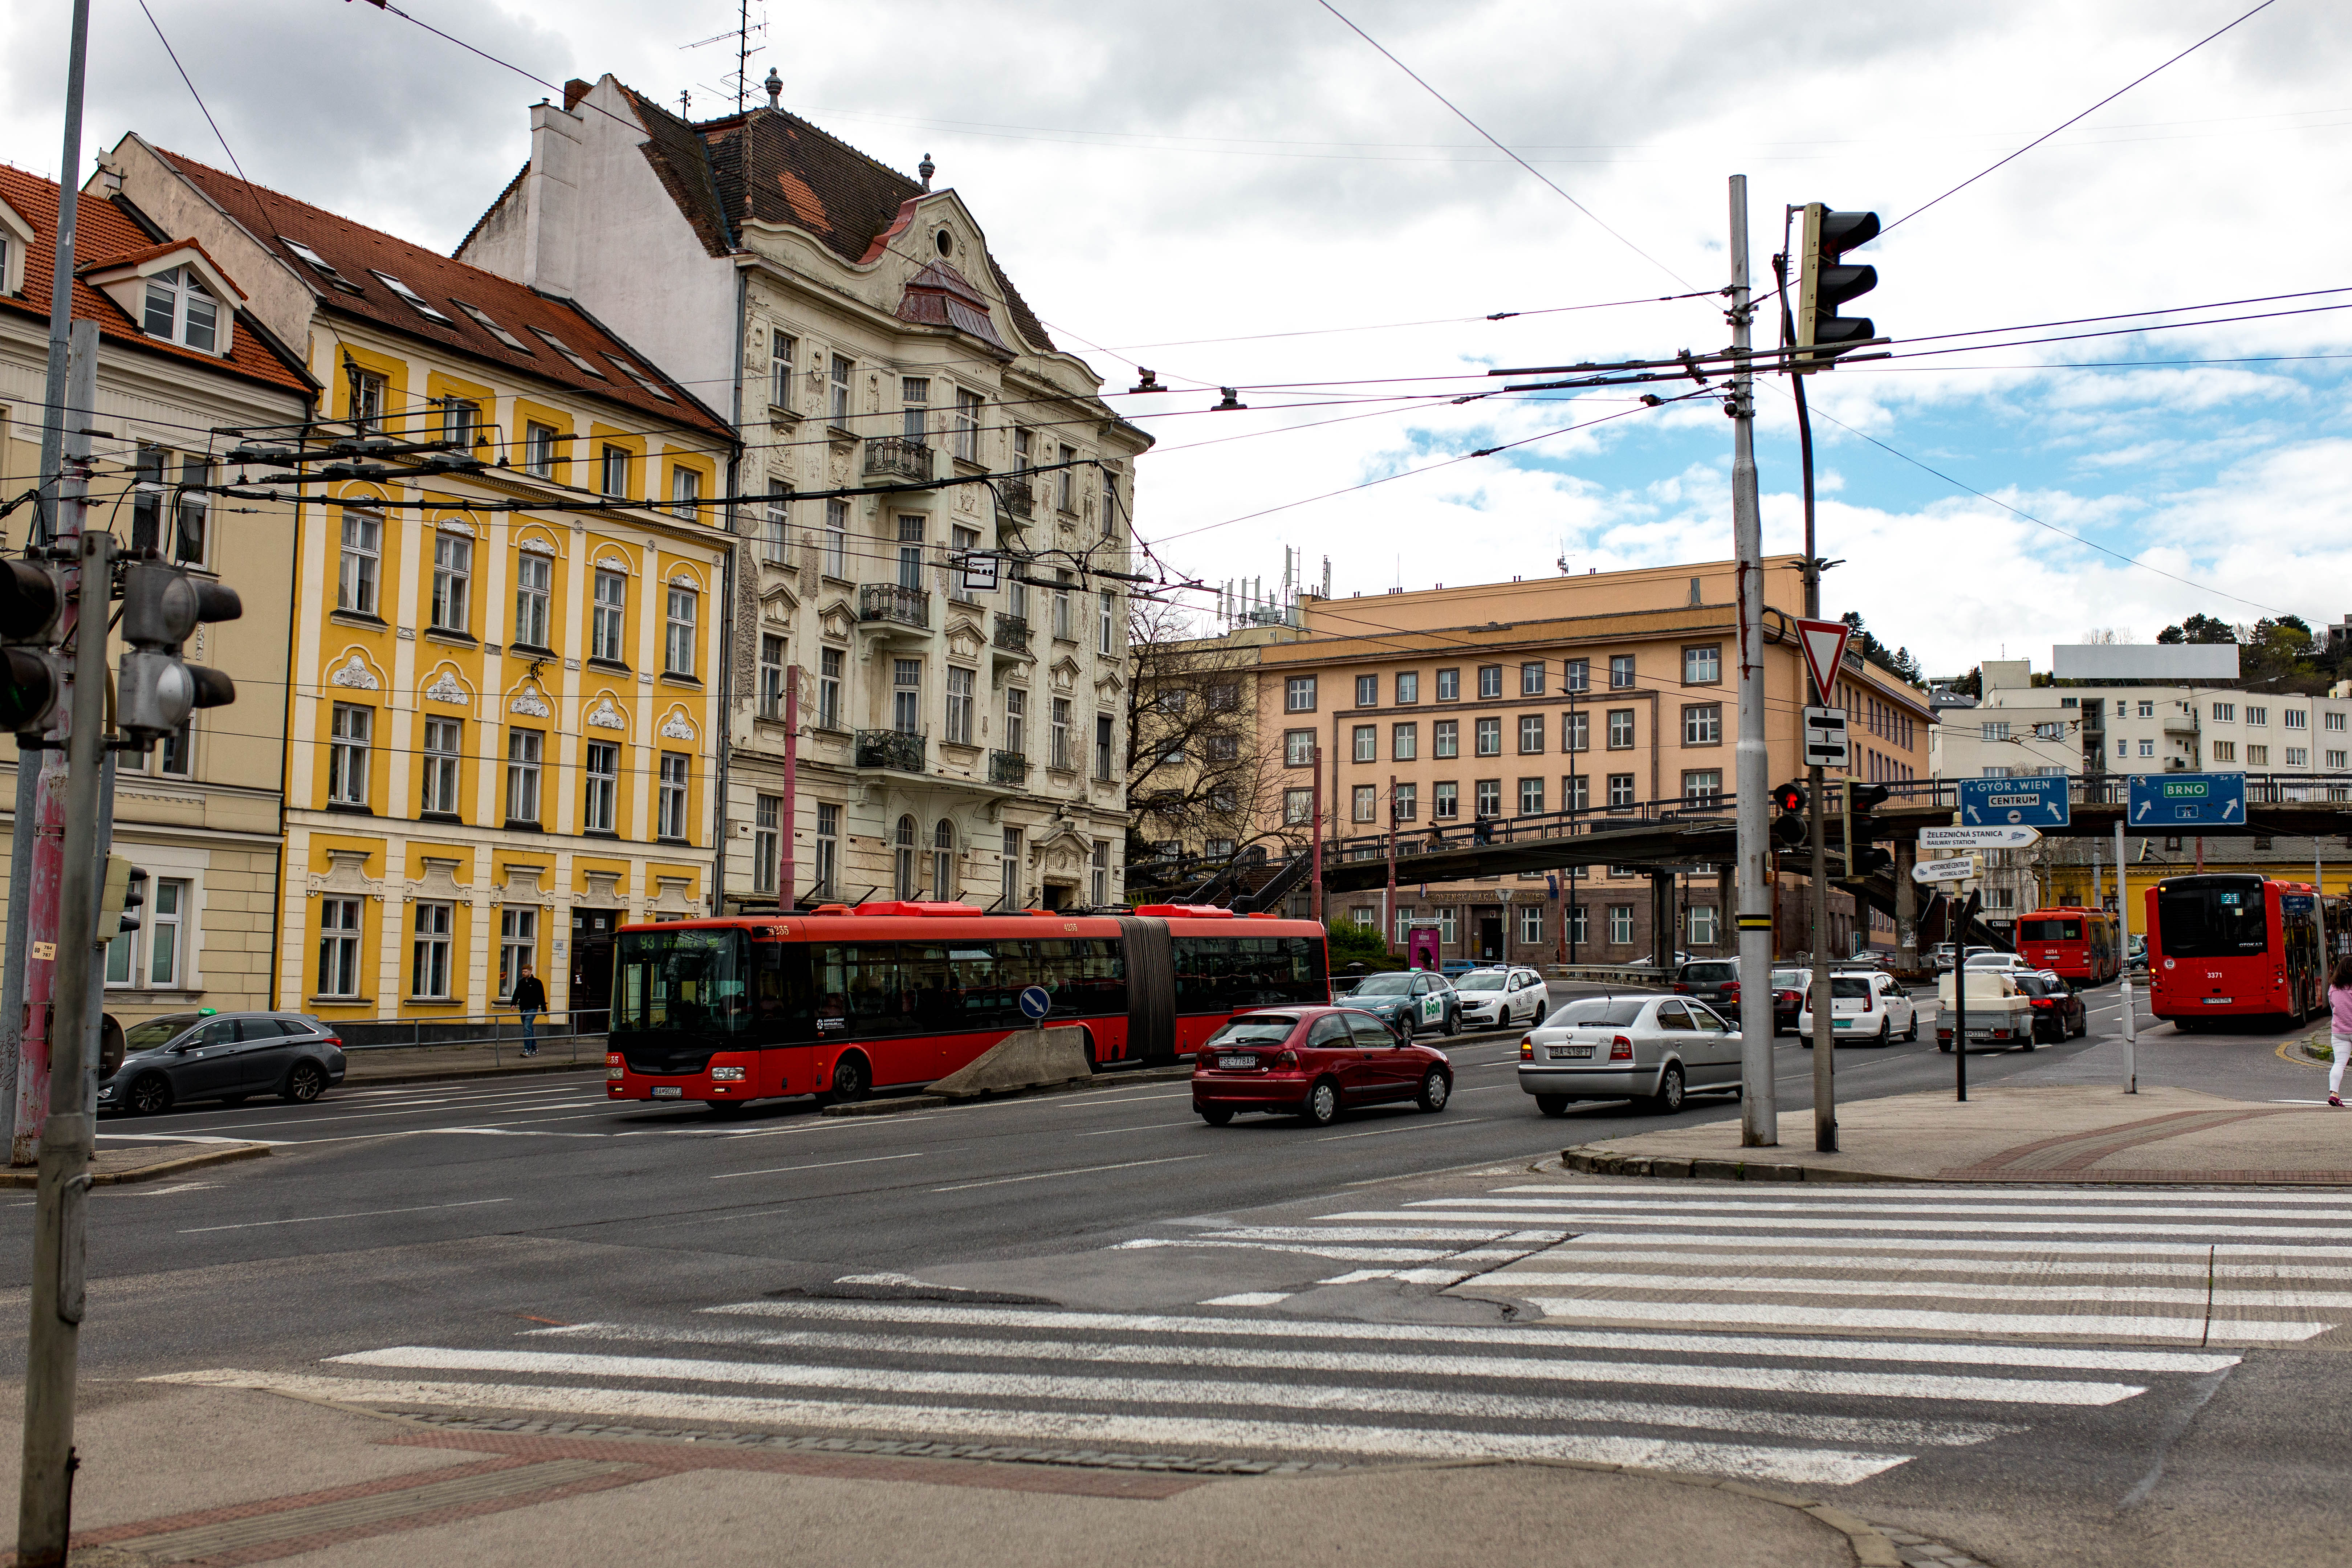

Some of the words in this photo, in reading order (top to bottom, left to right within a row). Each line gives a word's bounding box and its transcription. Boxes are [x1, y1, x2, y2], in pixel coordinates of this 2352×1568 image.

[2019, 780, 2050, 790] WIEN
[2167, 785, 2205, 794] BRNO
[1991, 796, 2037, 805] CENTRUM
[1930, 862, 1951, 871] HISTORICKÉ
[1427, 892, 1473, 902] SLOVENSKÁ
[1526, 892, 1546, 901] VIED
[769, 925, 789, 935] 4235
[1064, 923, 1078, 932] 4235
[640, 935, 655, 949] 93
[1425, 1001, 1440, 1016] Bolt
